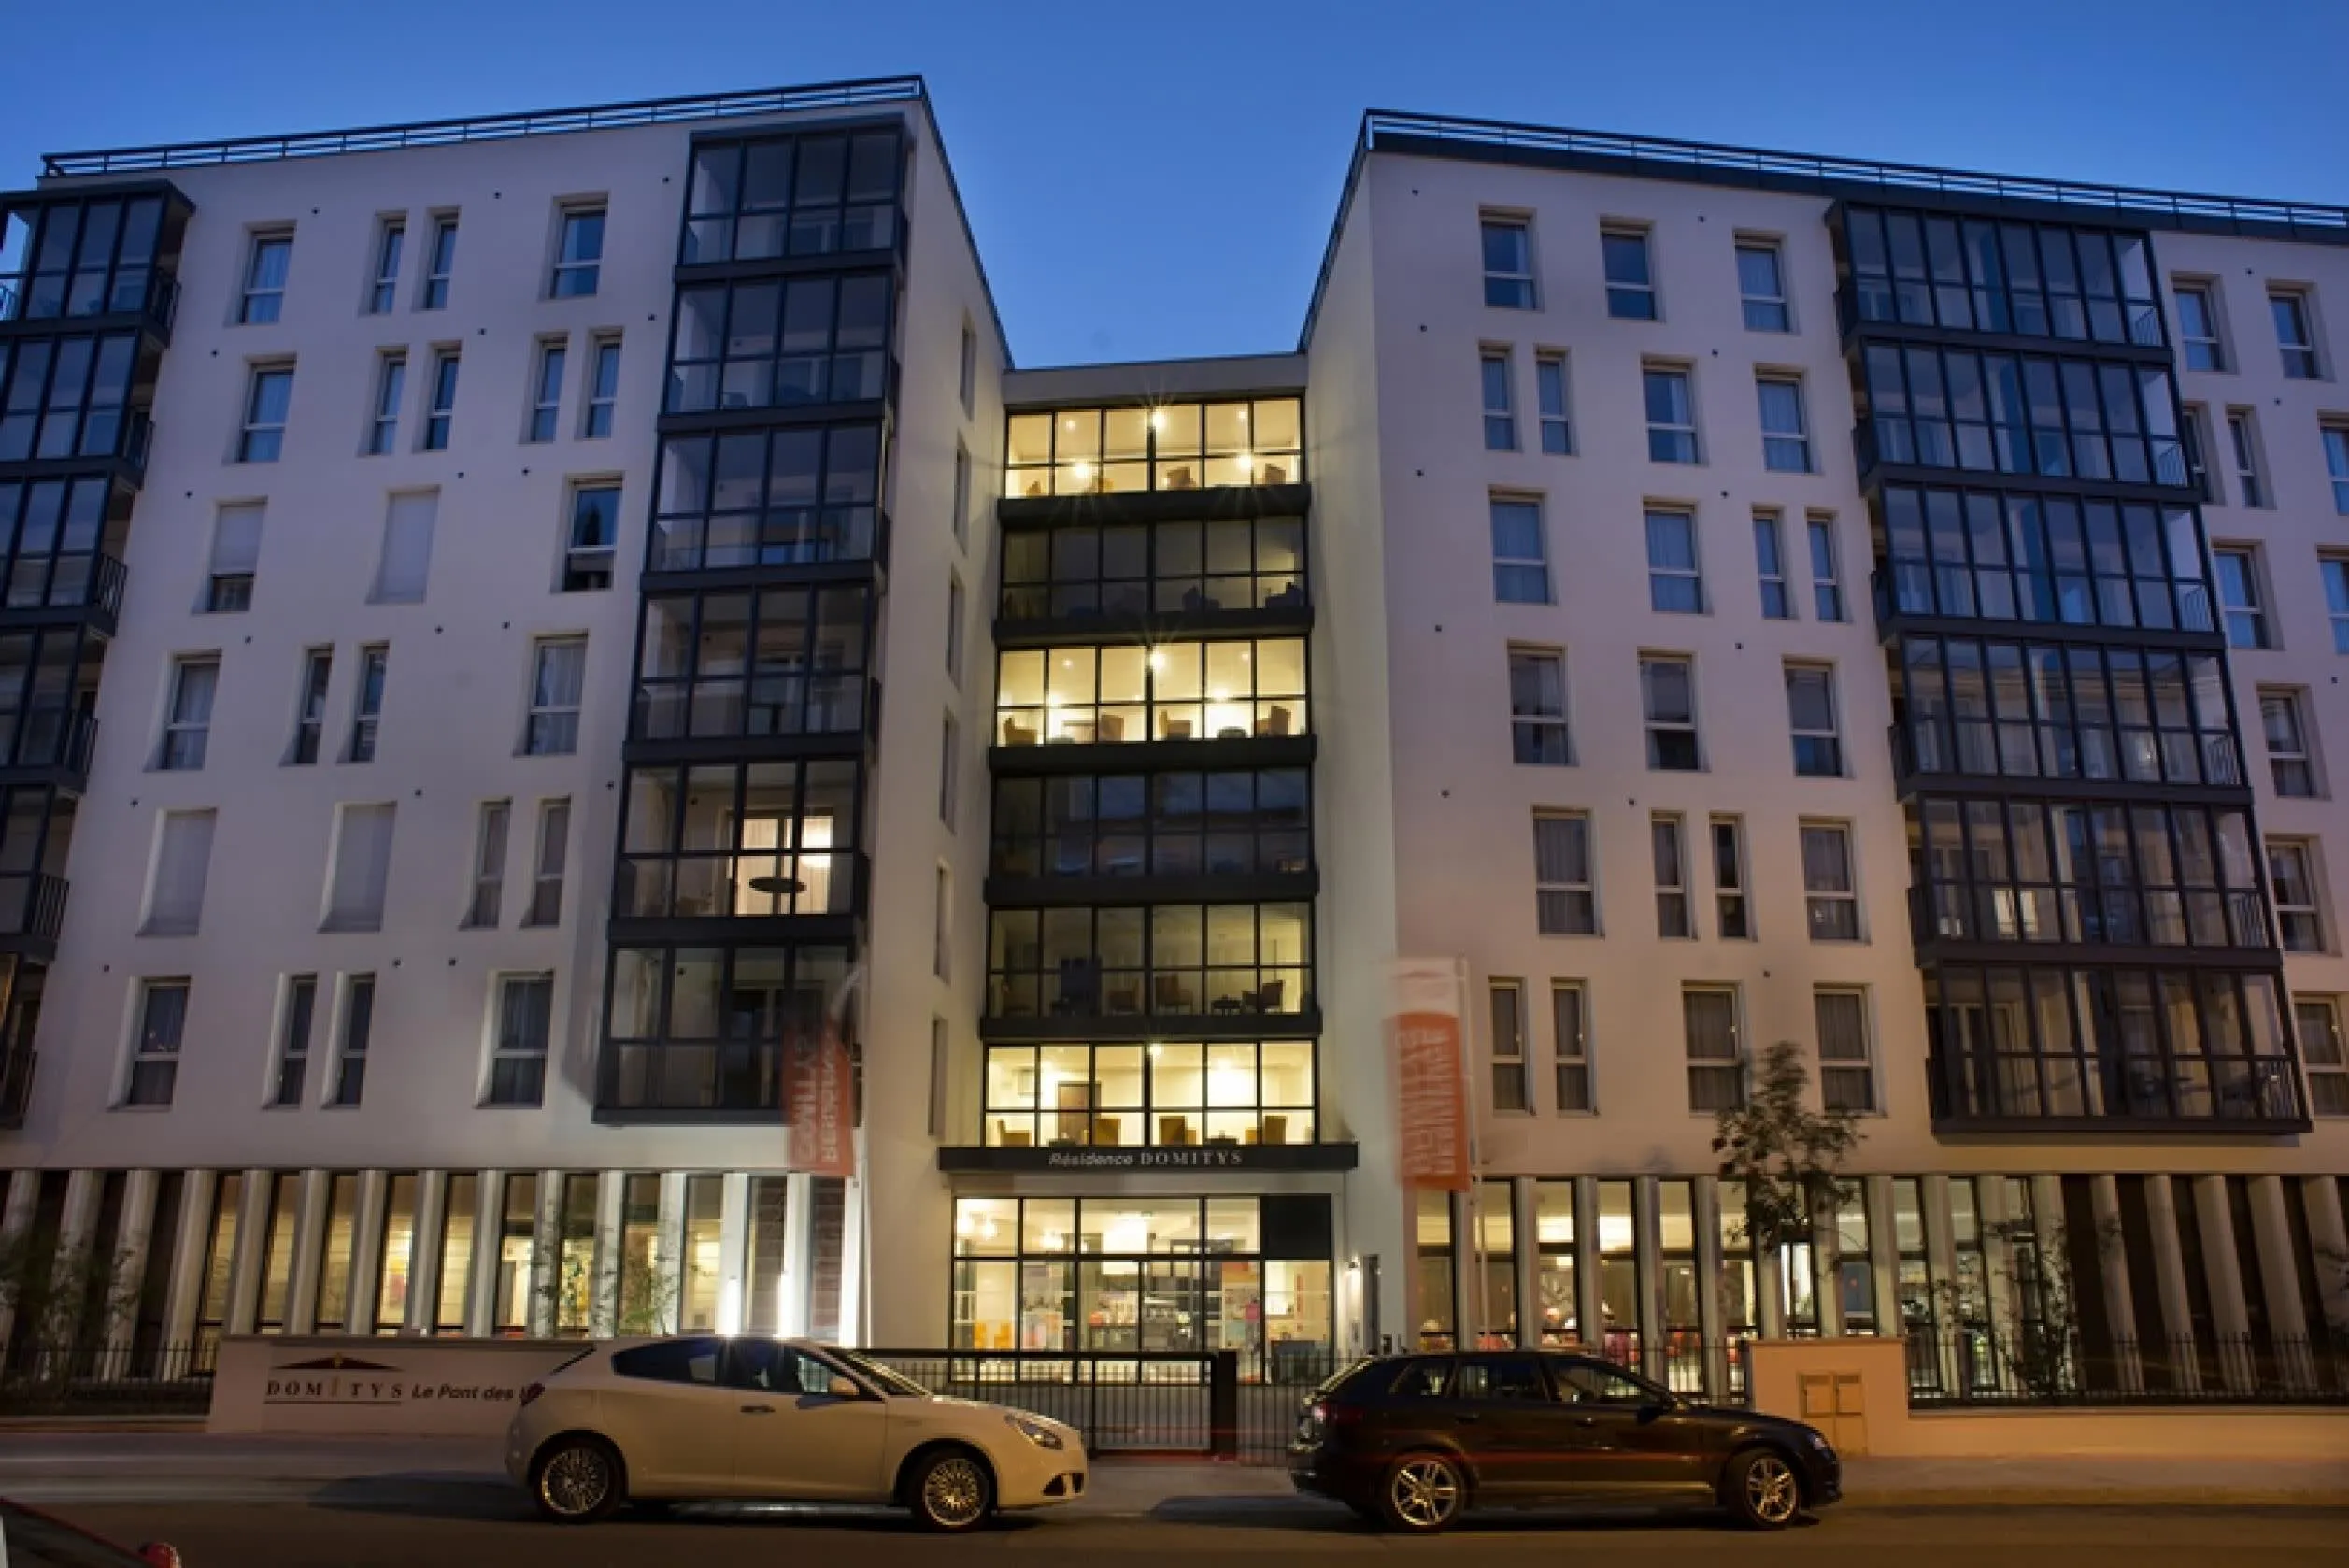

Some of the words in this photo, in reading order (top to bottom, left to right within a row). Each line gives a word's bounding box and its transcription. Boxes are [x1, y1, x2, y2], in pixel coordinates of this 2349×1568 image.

[1140, 1150, 1244, 1166] DOMITYS
[266, 1378, 402, 1399] DOMITYS
[411, 1382, 434, 1399] Le
[437, 1382, 479, 1400] Pont
[483, 1383, 514, 1401] des
